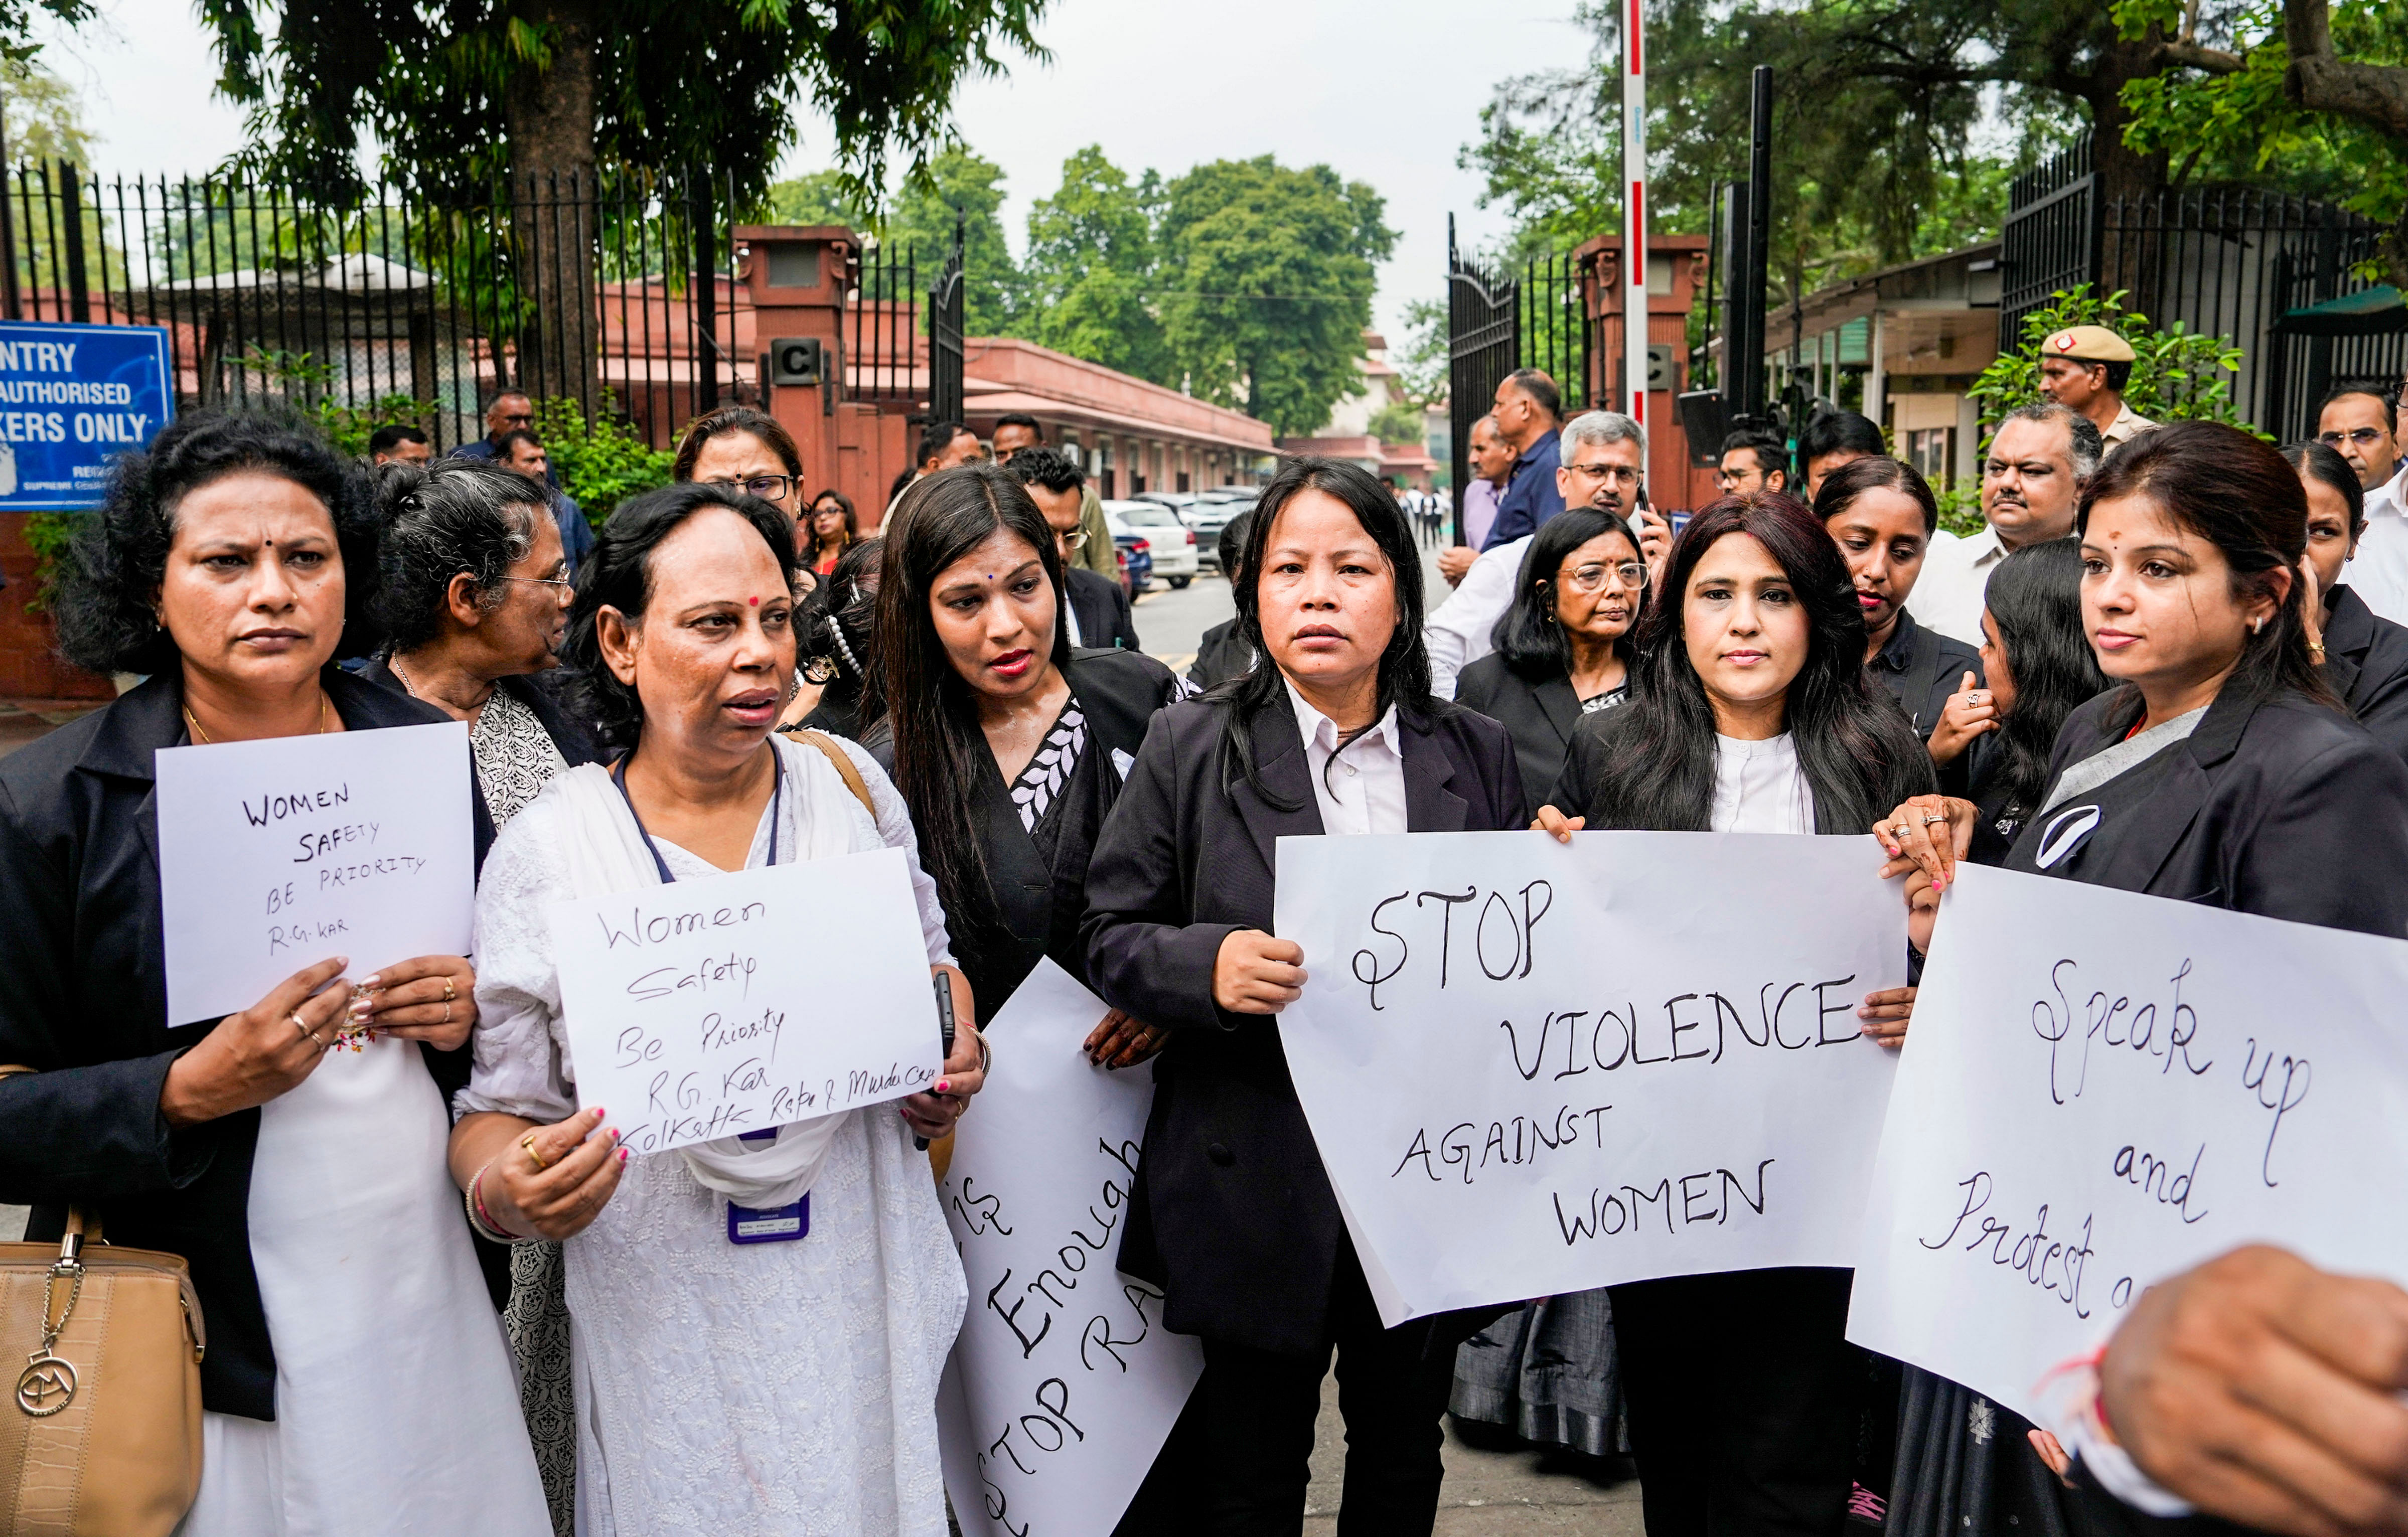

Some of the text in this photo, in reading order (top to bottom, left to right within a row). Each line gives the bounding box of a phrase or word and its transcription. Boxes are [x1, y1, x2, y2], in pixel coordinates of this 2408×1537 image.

[0, 341, 76, 372] NTRY
[782, 346, 810, 375] C
[74, 412, 147, 442] ONLY
[23, 481, 73, 491] SUPREME
[242, 783, 350, 828] WOMEN
[294, 822, 380, 863] SAFETY
[267, 857, 426, 915] BE PRIORITY
[598, 902, 765, 949] Women
[1352, 879, 1553, 1011] STOP
[627, 952, 757, 1002] Safety
[617, 1007, 785, 1069] Be Priority
[1500, 974, 1864, 1082] VIOLENCE
[770, 1081, 816, 1121] Rape
[904, 1065, 937, 1086] Case
[2032, 957, 2312, 1188] Speak up
[1391, 1104, 1612, 1184] AGAINST
[944, 1176, 1013, 1236] is
[1553, 1159, 1776, 1246] WOMEN
[2113, 1142, 2209, 1224] and
[987, 1136, 1142, 1359] Enough
[1918, 1171, 2094, 1319] Protest
[977, 1377, 1084, 1537] STOP
